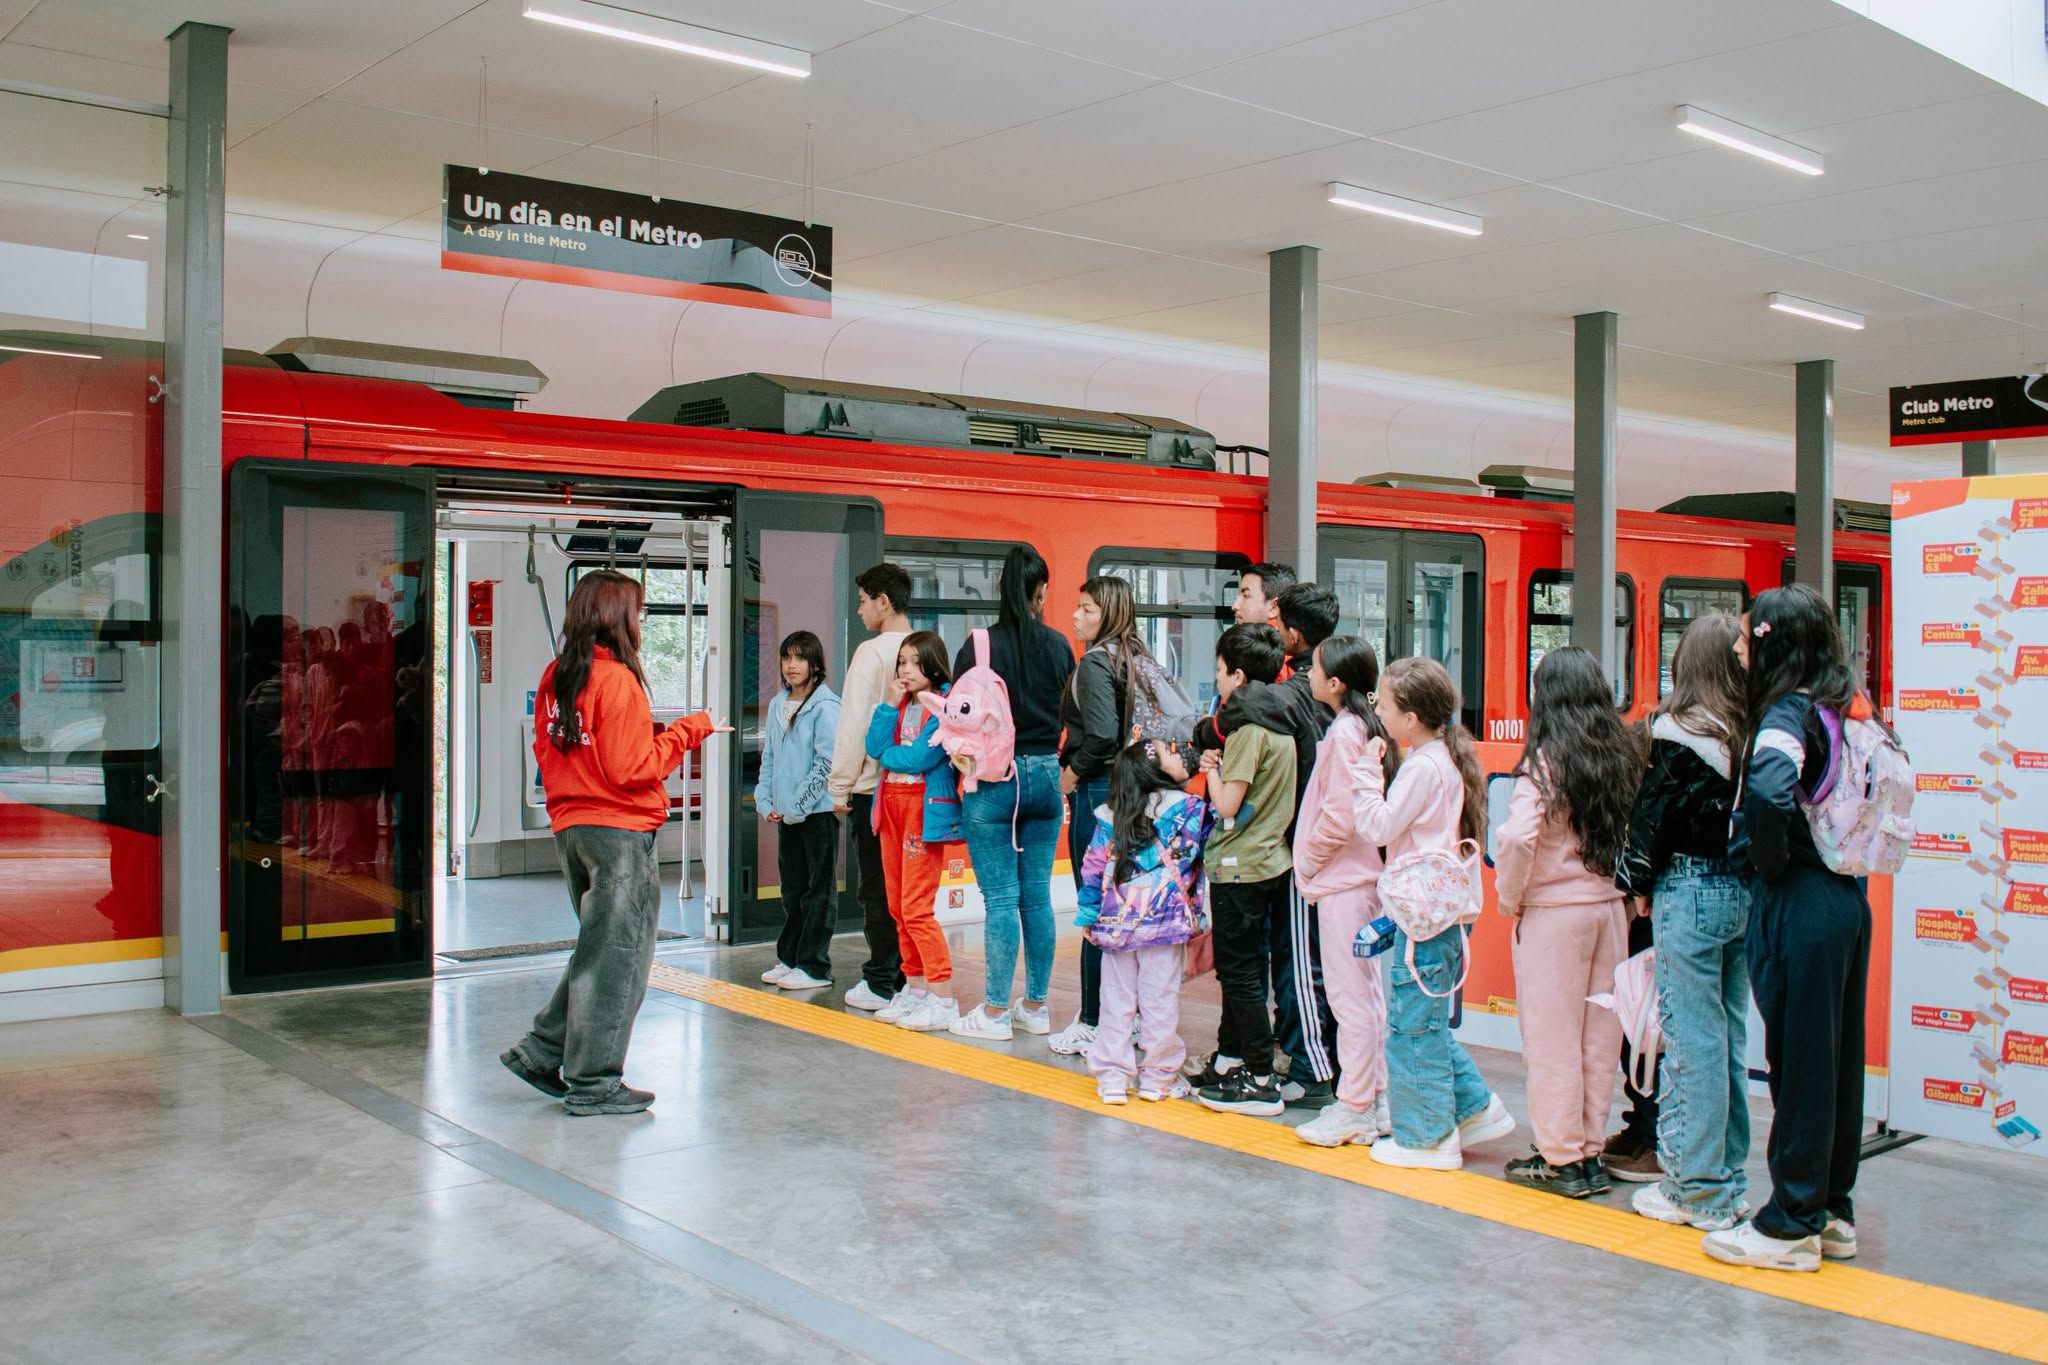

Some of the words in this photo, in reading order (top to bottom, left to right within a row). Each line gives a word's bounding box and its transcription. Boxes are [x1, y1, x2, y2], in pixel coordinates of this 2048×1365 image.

[464, 194, 501, 220] Un
[510, 202, 551, 228] día
[560, 212, 592, 234] en
[600, 215, 622, 238] el
[630, 219, 703, 249] Metro
[464, 224, 474, 236] A
[478, 226, 504, 242] day
[508, 230, 520, 242] in
[524, 232, 546, 246] the
[549, 236, 587, 252] Metro
[1902, 399, 1939, 415] Club
[1944, 397, 1994, 412] Metro
[1902, 418, 1926, 426] Metro
[1928, 416, 1946, 425] club
[2019, 518, 2034, 528] 72
[1926, 553, 1953, 562] Calle
[1926, 563, 1940, 572] 63
[2021, 596, 2038, 606] 45
[1924, 630, 1965, 640] Central
[1901, 698, 1956, 709] HOSPITAL
[1489, 719, 1524, 740] 10101
[1918, 780, 1950, 790] SENA
[1917, 917, 1961, 932] Hospital
[1917, 927, 1965, 941] Kennedy
[2008, 1041, 2044, 1055] Portal
[1926, 1088, 1975, 1104] Gibraltar
